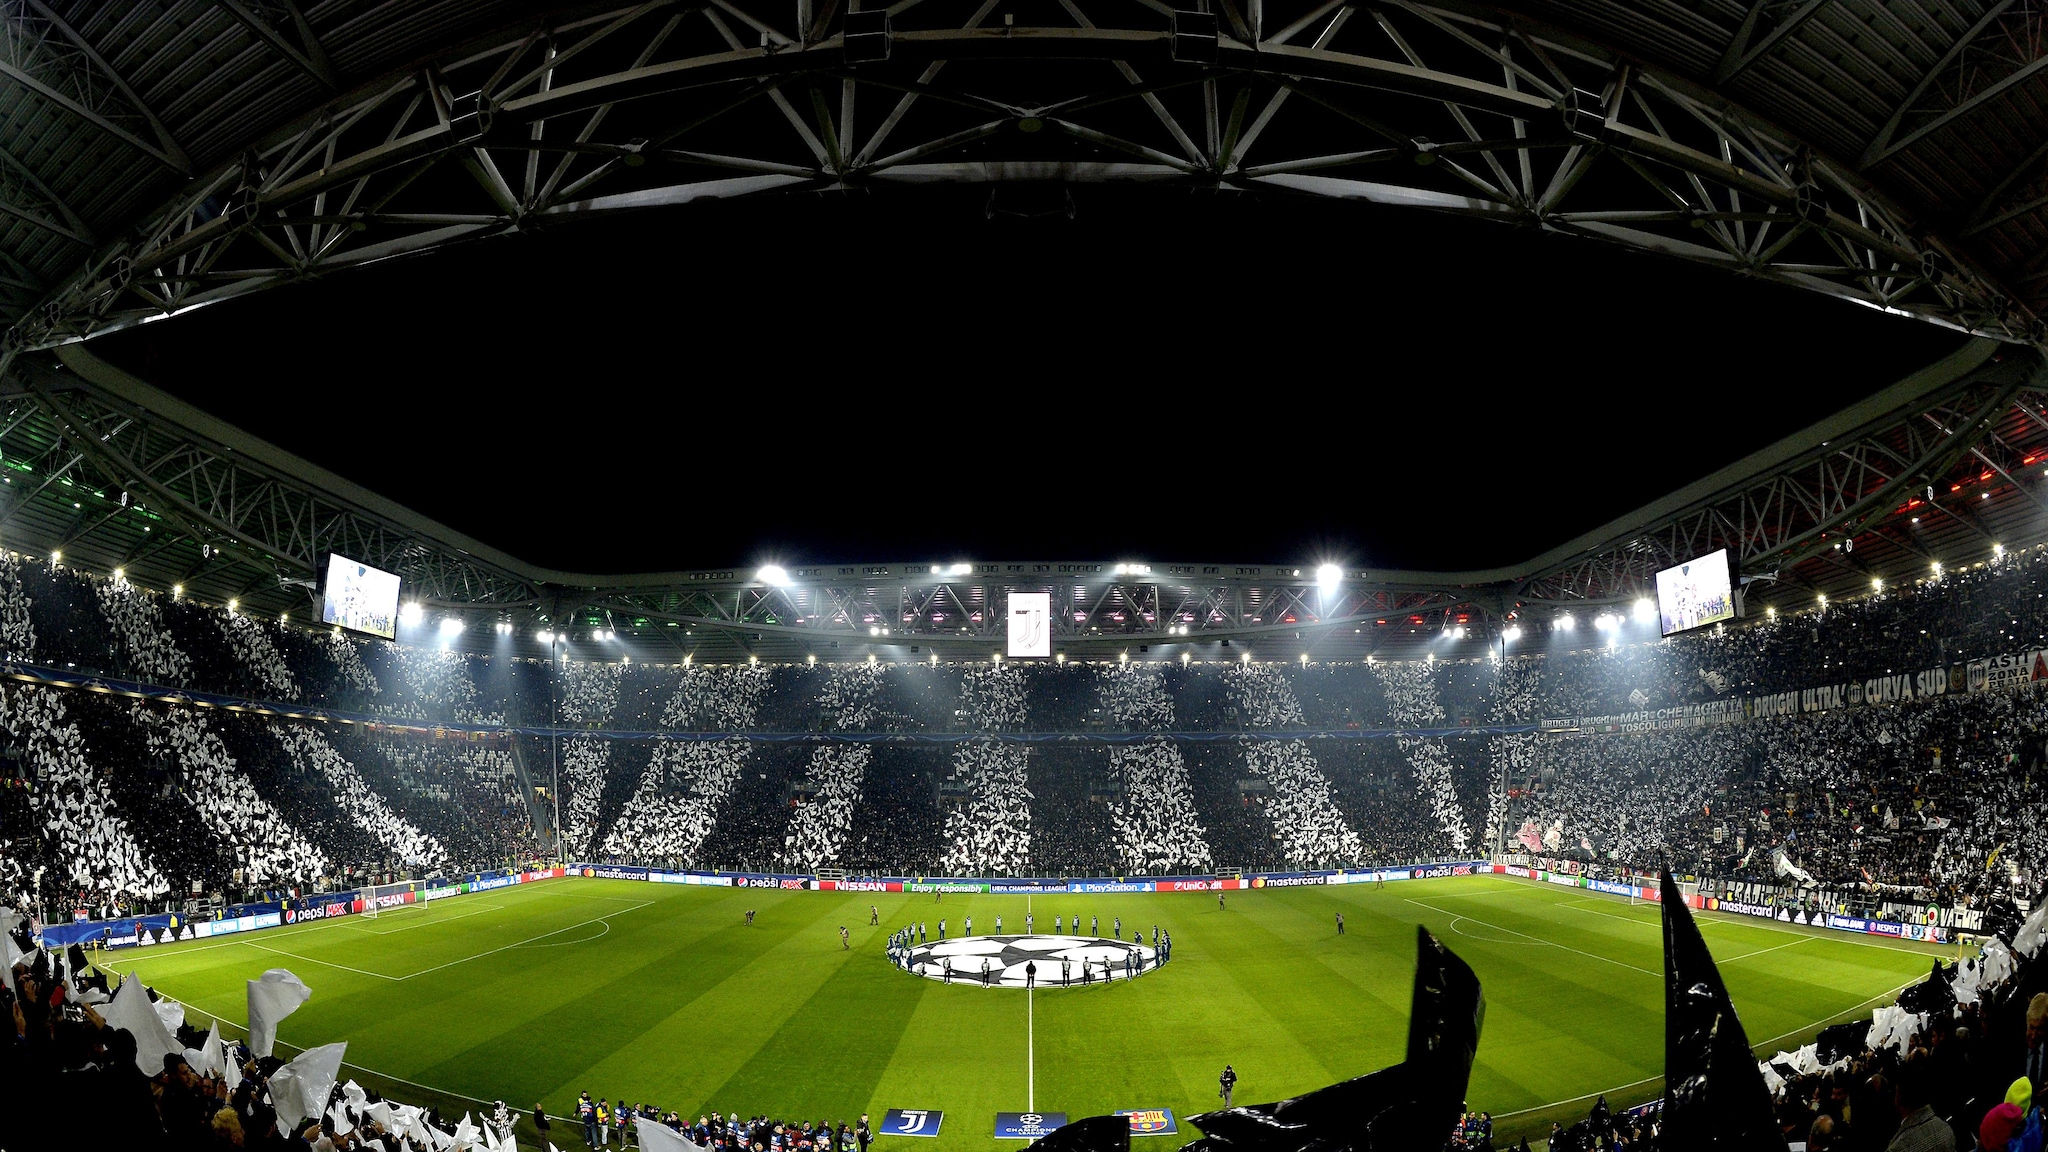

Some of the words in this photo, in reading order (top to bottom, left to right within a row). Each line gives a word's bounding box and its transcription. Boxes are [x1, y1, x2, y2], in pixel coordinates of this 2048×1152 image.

[1989, 652, 2028, 670] ASTI
[1988, 667, 2029, 681] ZONA
[1865, 673, 1912, 704] CURVA
[1917, 667, 1947, 697] SUD
[1684, 697, 1744, 718] MAGENTA
[1753, 690, 1799, 718] DRUGHI
[1580, 726, 1595, 735] SUD
[596, 868, 646, 881] mastercard
[1426, 866, 1450, 878] pepsi
[1452, 865, 1472, 876] MAX
[1505, 866, 1530, 878] NISSAN
[480, 878, 508, 890] PlayStation
[750, 878, 778, 889] pepsi
[780, 879, 805, 890] MAX
[835, 881, 887, 892] NISSAN
[1266, 876, 1324, 888] mastercard
[1549, 874, 1575, 887] Heineken
[911, 883, 933, 893] Enjoy
[936, 883, 983, 893] Responsibly
[1086, 883, 1137, 893] PlayStation
[1598, 881, 1631, 895] PlayStation
[298, 905, 325, 922] pepsi
[325, 902, 347, 917] MAX
[1720, 901, 1773, 918] mastercard
[1876, 923, 1901, 934] RESPECT
